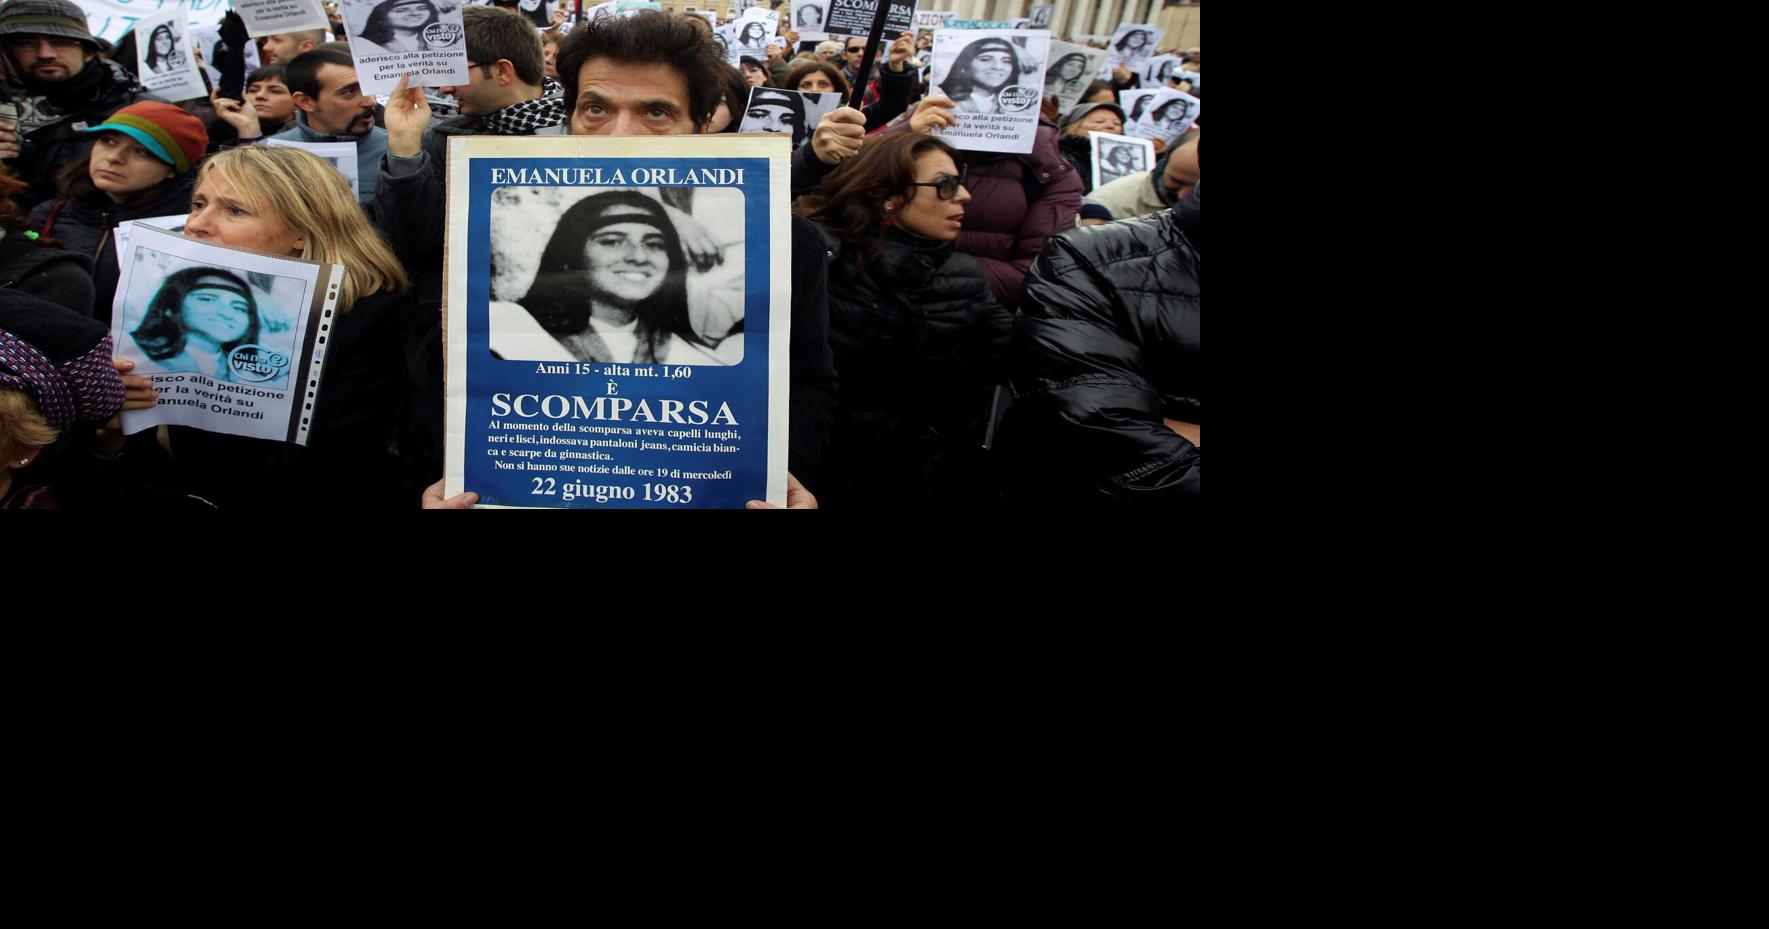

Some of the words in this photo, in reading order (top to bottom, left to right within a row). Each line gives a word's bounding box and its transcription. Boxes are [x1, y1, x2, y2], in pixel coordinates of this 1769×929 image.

[359, 55, 400, 64] aderisco
[403, 51, 419, 60] alla
[422, 50, 464, 60] petizione
[379, 63, 394, 72] per
[397, 61, 405, 69] la
[408, 59, 433, 68] verità
[991, 115, 1034, 123] petizione
[940, 130, 983, 138] Emanuela
[985, 131, 1020, 140] Orlandi
[491, 168, 627, 184] EMANUELA
[631, 168, 745, 184] ORLANDI
[535, 363, 571, 374] Anni
[575, 364, 590, 374] 15
[603, 365, 630, 376] alta
[634, 367, 658, 377] mt.
[662, 366, 691, 379] 1,60
[189, 375, 213, 387] alla
[217, 383, 285, 400] petizione
[606, 379, 618, 395] È
[176, 385, 189, 394] la
[194, 387, 232, 404] verità
[236, 399, 254, 408] su
[157, 398, 207, 410] anuela
[210, 404, 264, 420] Orlandi
[491, 393, 739, 425] SCOMPARSA
[488, 420, 500, 429] Al
[503, 422, 549, 431] momento
[552, 423, 576, 432] della
[579, 425, 632, 436] scomparsa
[635, 428, 664, 437] aveva
[668, 429, 701, 439] capelli
[704, 430, 741, 441] lunghi,
[488, 434, 508, 443] neri
[516, 435, 539, 445] lisci,
[540, 435, 589, 446] indossava
[590, 437, 638, 448] pantaloni
[639, 440, 671, 451] jeans,
[671, 443, 712, 452] camicia
[713, 443, 740, 453] bian-
[509, 449, 542, 459] scarpe
[544, 448, 557, 458] da
[559, 449, 614, 461] ginnastica.
[494, 460, 514, 470] Non
[517, 461, 525, 470] si
[527, 461, 557, 472] hanno
[559, 464, 576, 472] sue
[578, 464, 609, 474] notizie
[612, 465, 636, 475] dalle
[638, 468, 654, 476] ore
[657, 468, 668, 477] 19
[670, 469, 680, 479] di
[683, 470, 732, 480] mercoledì
[531, 477, 556, 495] 22
[562, 479, 636, 503] giugno
[642, 482, 693, 504] 1983
